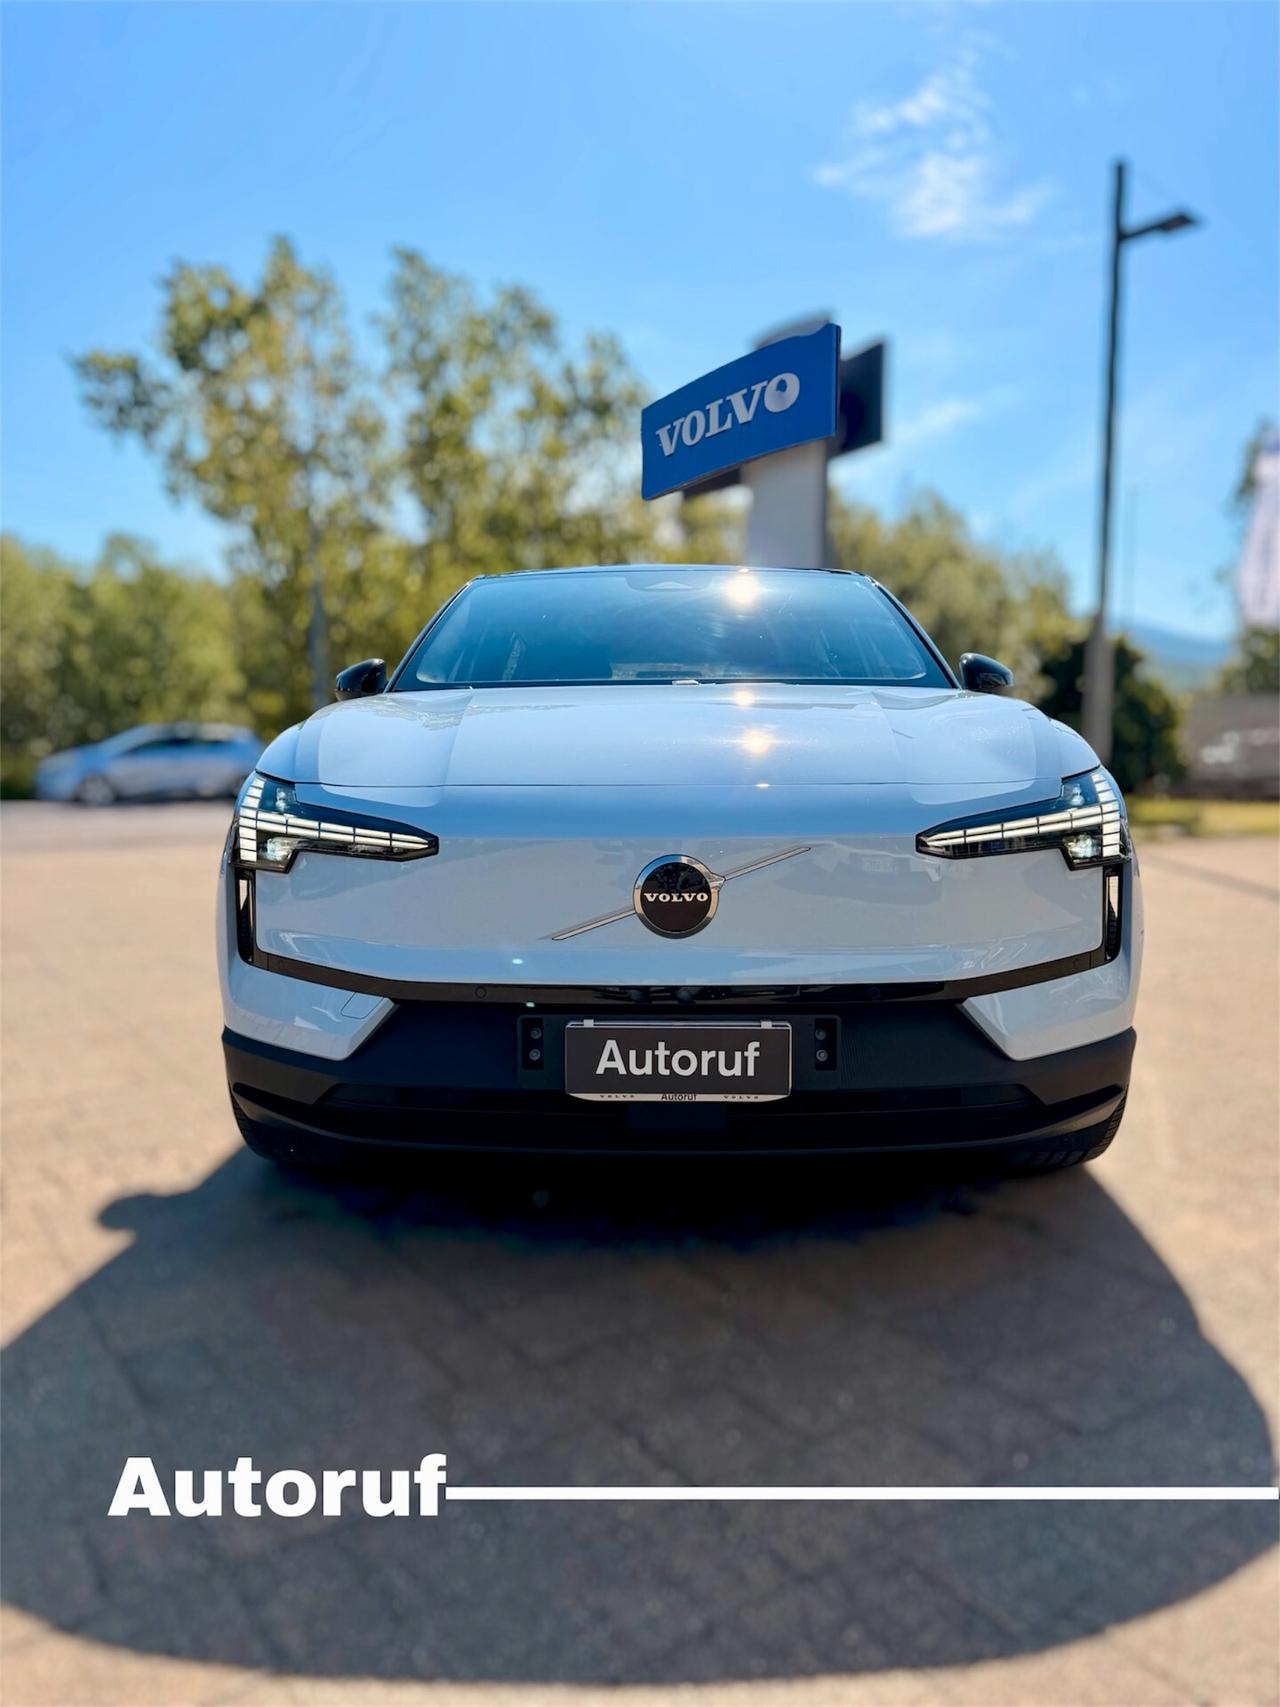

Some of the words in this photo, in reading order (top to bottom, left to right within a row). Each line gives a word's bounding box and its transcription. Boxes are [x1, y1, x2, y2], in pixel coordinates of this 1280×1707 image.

[655, 372, 800, 457] VOLVO
[643, 892, 709, 902] VOLVO
[595, 1039, 760, 1076] Autoruf
[661, 1093, 697, 1101] Autoruf
